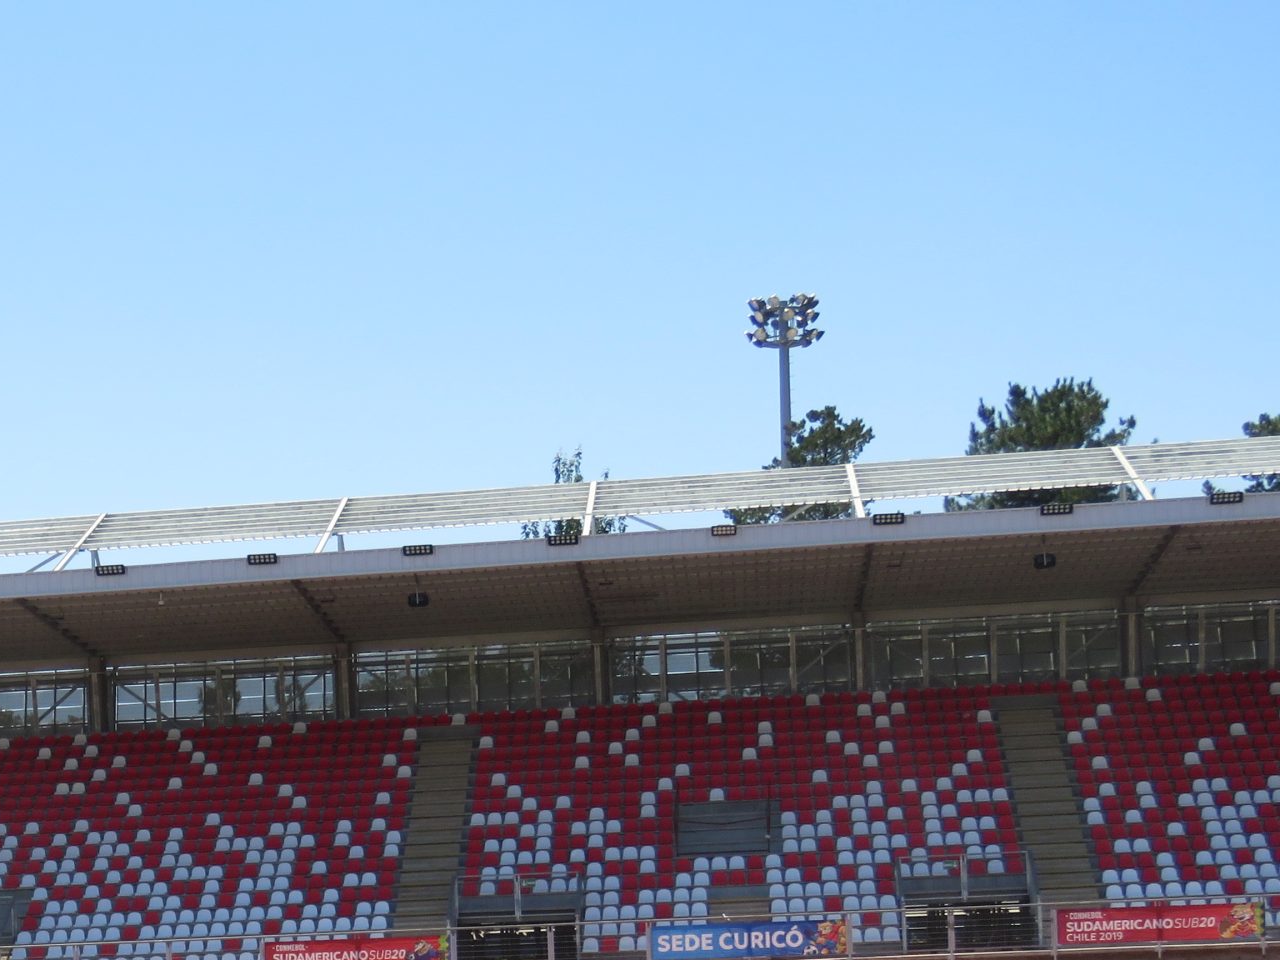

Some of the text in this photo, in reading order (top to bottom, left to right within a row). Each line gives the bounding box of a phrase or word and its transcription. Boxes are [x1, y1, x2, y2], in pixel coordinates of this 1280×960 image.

[1066, 918, 1173, 932] SUDAMERICANO
[657, 925, 803, 952] SEDE CURICÓ
[1066, 932, 1123, 942] CHILE 2019
